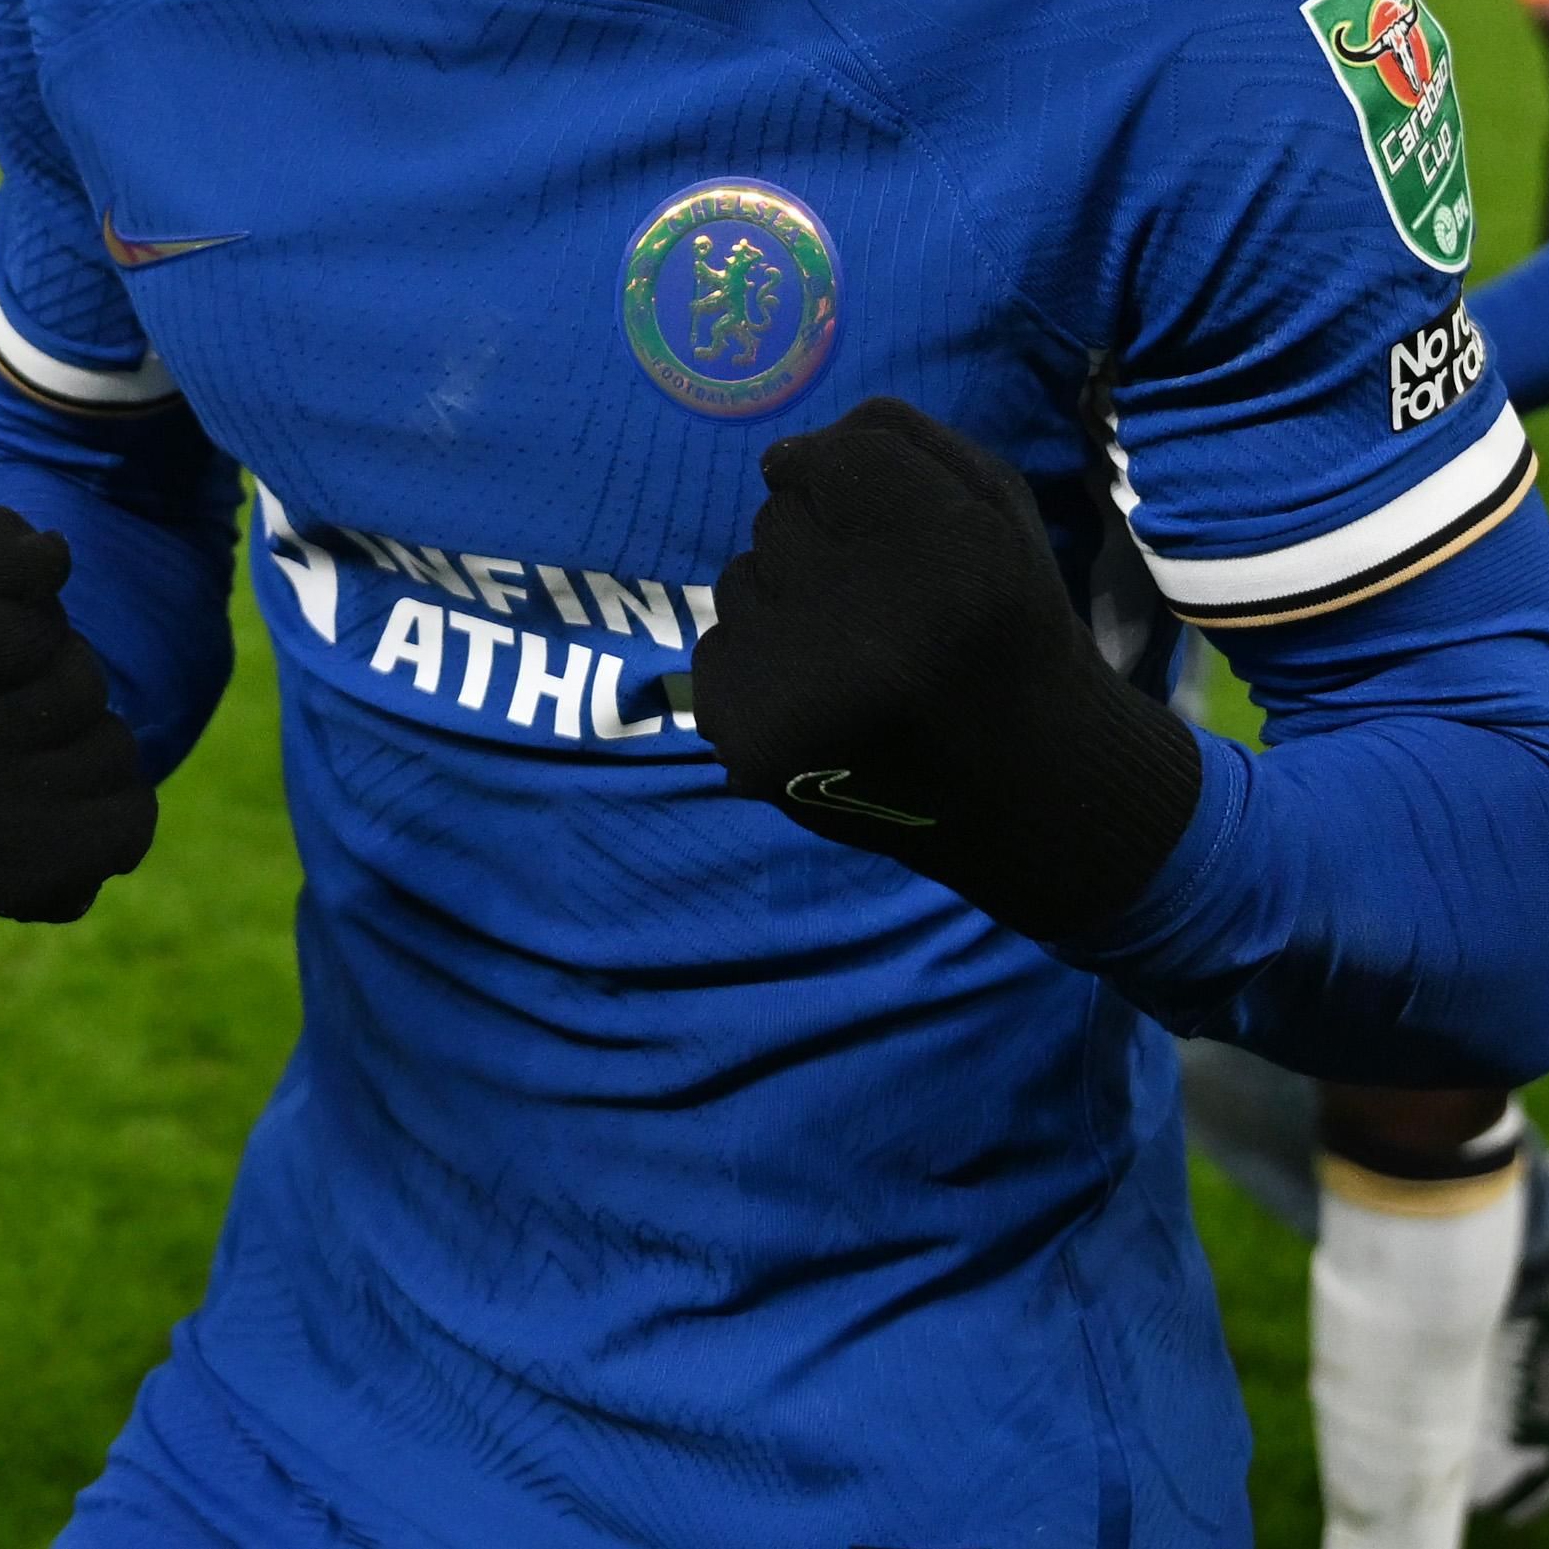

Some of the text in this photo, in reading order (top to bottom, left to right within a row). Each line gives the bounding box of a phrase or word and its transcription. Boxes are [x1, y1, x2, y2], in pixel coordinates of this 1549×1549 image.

[1380, 54, 1448, 177] Carabao
[1418, 120, 1452, 187] Cup
[665, 194, 802, 249] CHELSEA
[1391, 328, 1448, 389] No
